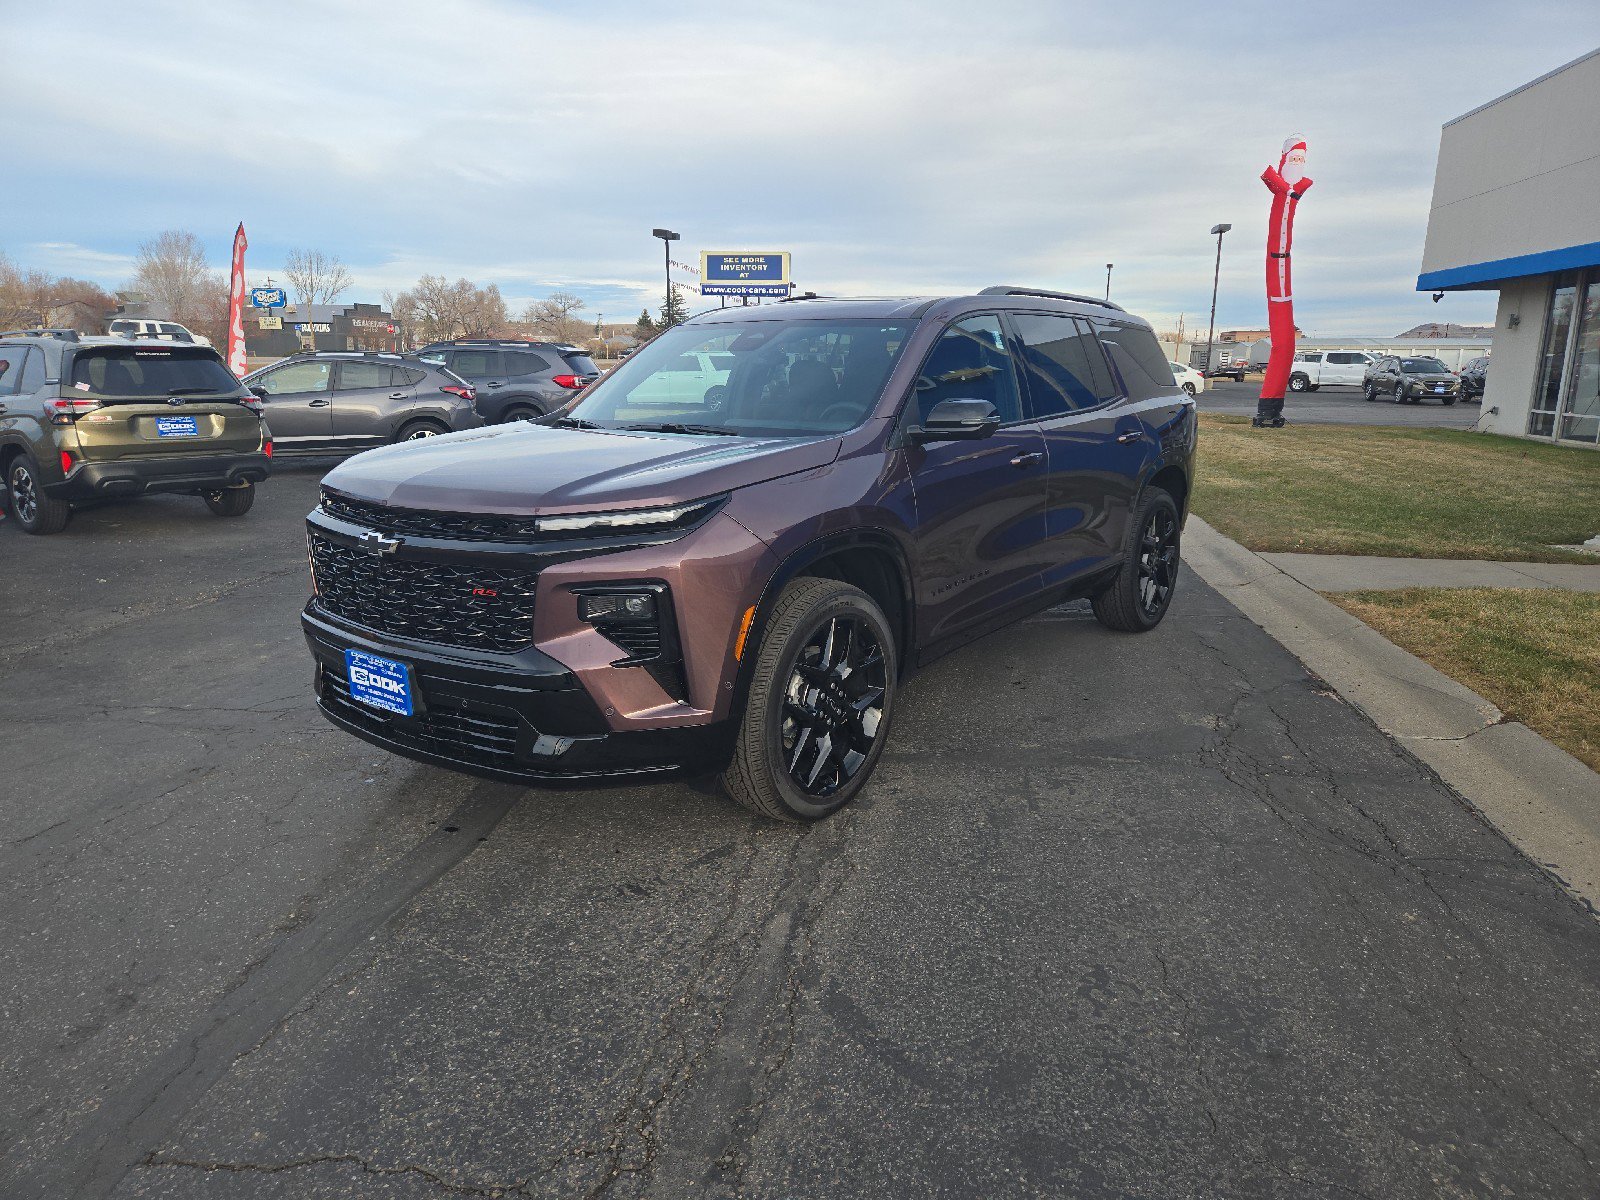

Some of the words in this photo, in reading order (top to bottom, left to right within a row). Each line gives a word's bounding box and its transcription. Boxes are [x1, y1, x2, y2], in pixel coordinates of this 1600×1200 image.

[704, 286, 786, 294] www.cook-cars.com
[472, 588, 497, 597] RS
[350, 666, 406, 695] COOK
